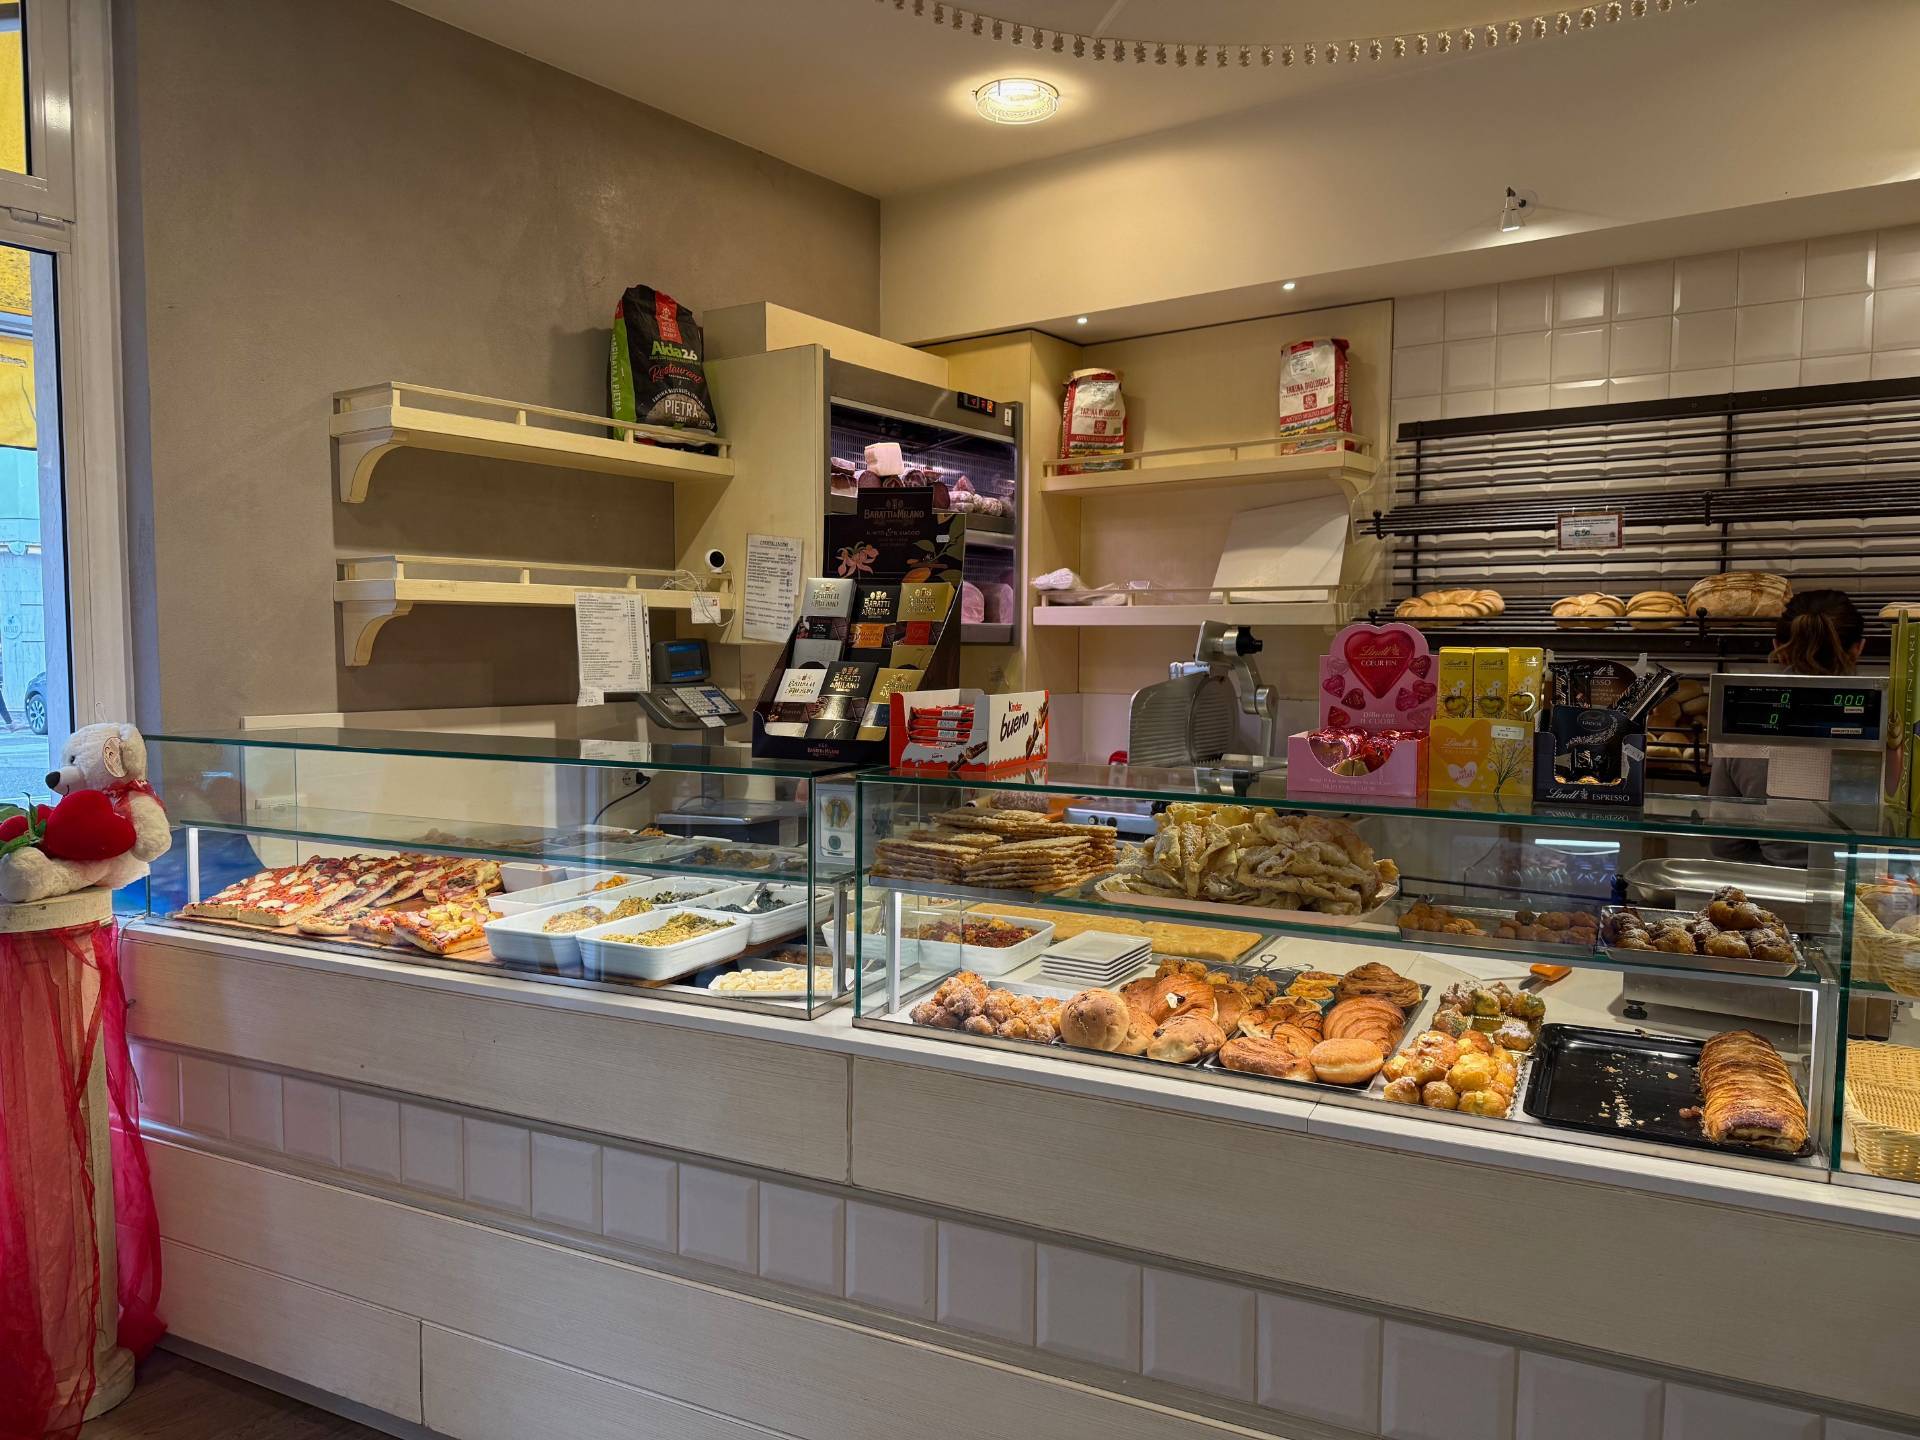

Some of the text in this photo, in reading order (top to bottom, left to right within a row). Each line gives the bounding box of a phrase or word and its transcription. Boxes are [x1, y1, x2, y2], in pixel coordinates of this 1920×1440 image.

[1286, 384, 1304, 394] FARINA
[1304, 377, 1331, 390] BIOLOGICA
[613, 384, 622, 413] PIETRA
[664, 399, 699, 418] PIETRA
[864, 598, 891, 608] BARATTI
[1359, 645, 1393, 656] Lindt
[832, 673, 861, 683] BARATTI
[1905, 630, 1916, 712] TENTARE
[1000, 711, 1030, 742] bueno
[1545, 788, 1631, 802] Lindt ESPRESSO
